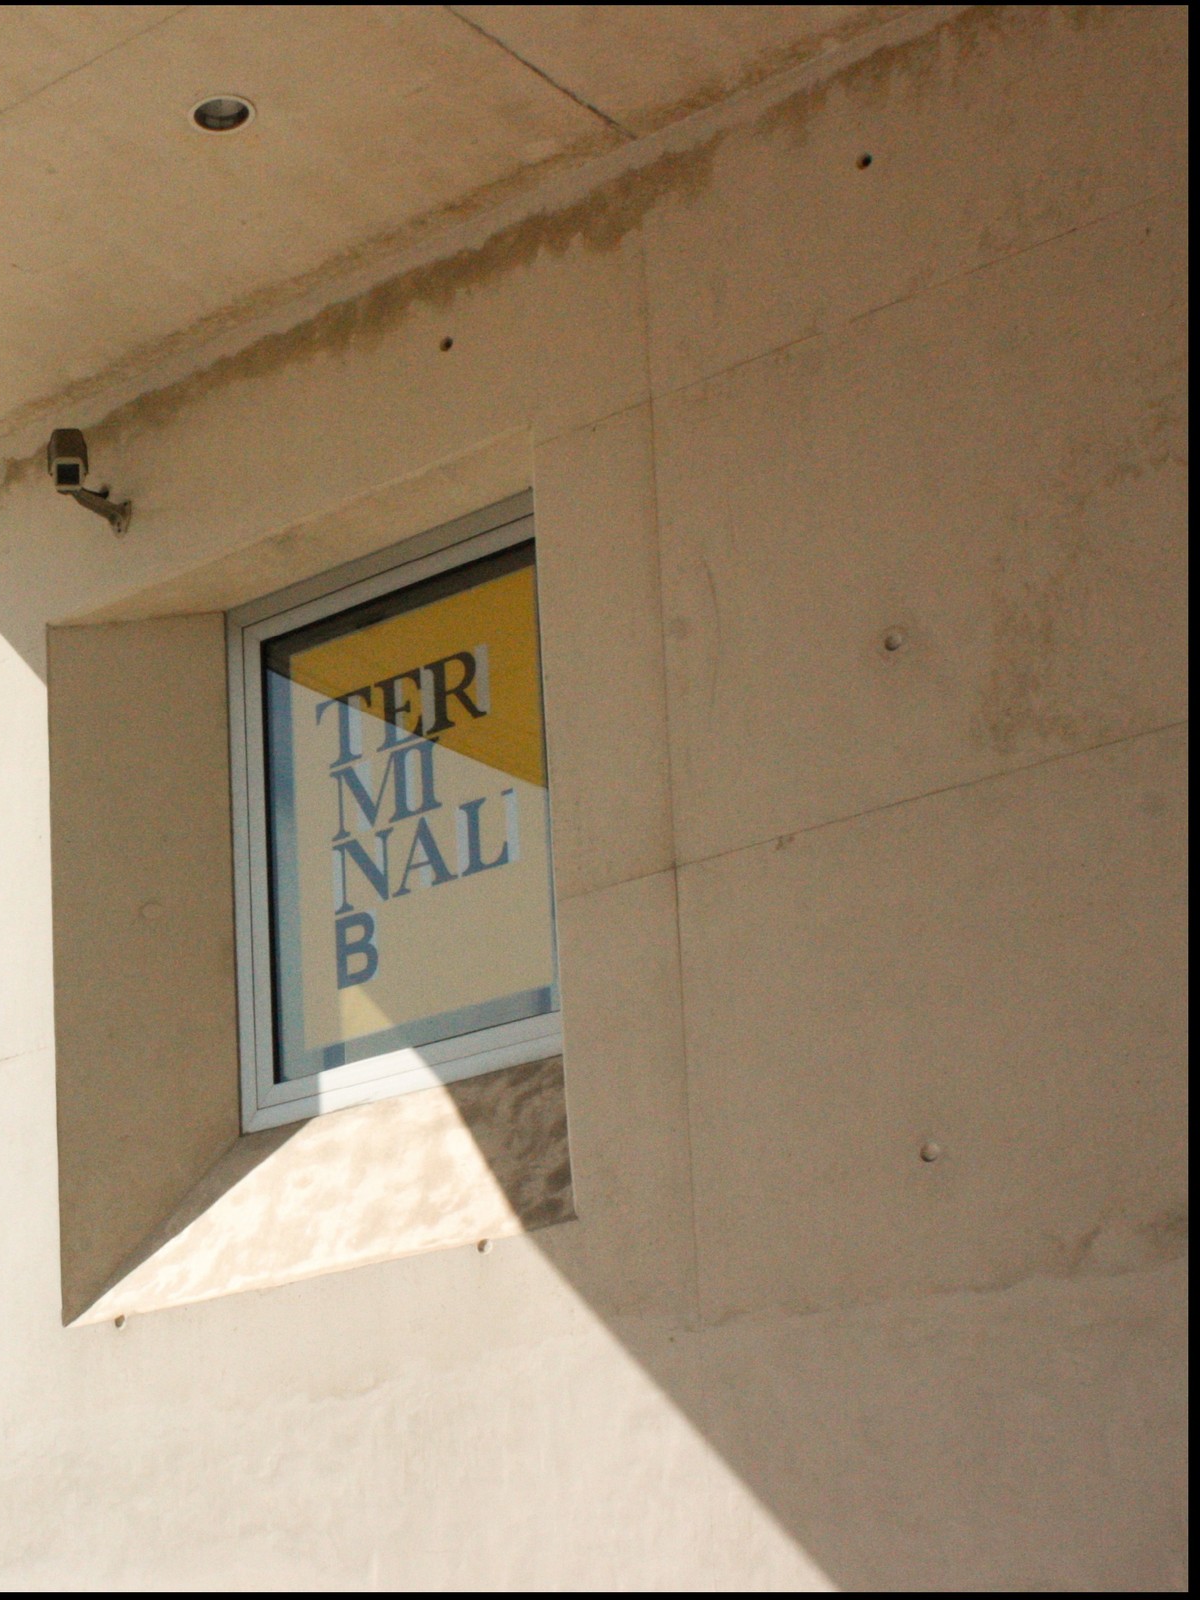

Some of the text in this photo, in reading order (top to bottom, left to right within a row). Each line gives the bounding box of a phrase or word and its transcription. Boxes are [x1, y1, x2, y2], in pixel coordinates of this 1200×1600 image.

[315, 651, 488, 769] TER
[329, 736, 443, 842] MI
[334, 911, 379, 990] B
